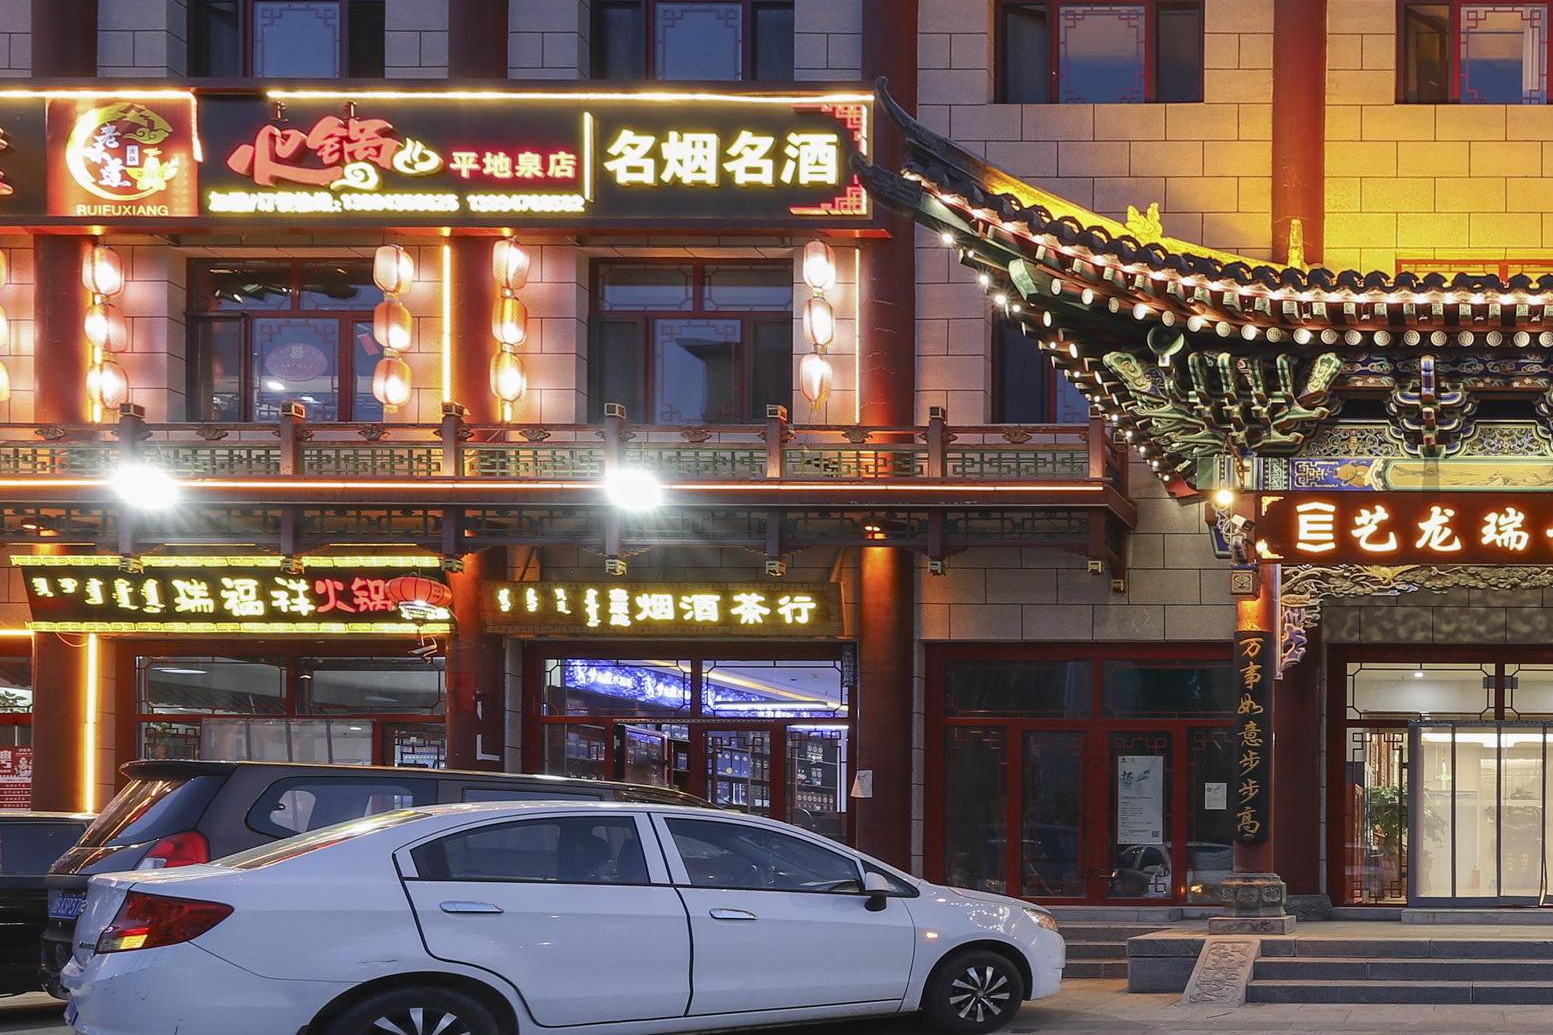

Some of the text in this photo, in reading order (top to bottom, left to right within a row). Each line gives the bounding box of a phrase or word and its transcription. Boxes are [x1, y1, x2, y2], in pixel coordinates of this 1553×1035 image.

[225, 115, 401, 189] 火锅
[450, 150, 578, 179] 平地泉店
[603, 129, 840, 187] 名烟名酒
[76, 204, 169, 216] RUIFUXIANG
[171, 575, 451, 620] 瑞福祥火锅
[634, 592, 817, 625] 烟酒茶行
[1237, 637, 1265, 834] 万事如意步步高
